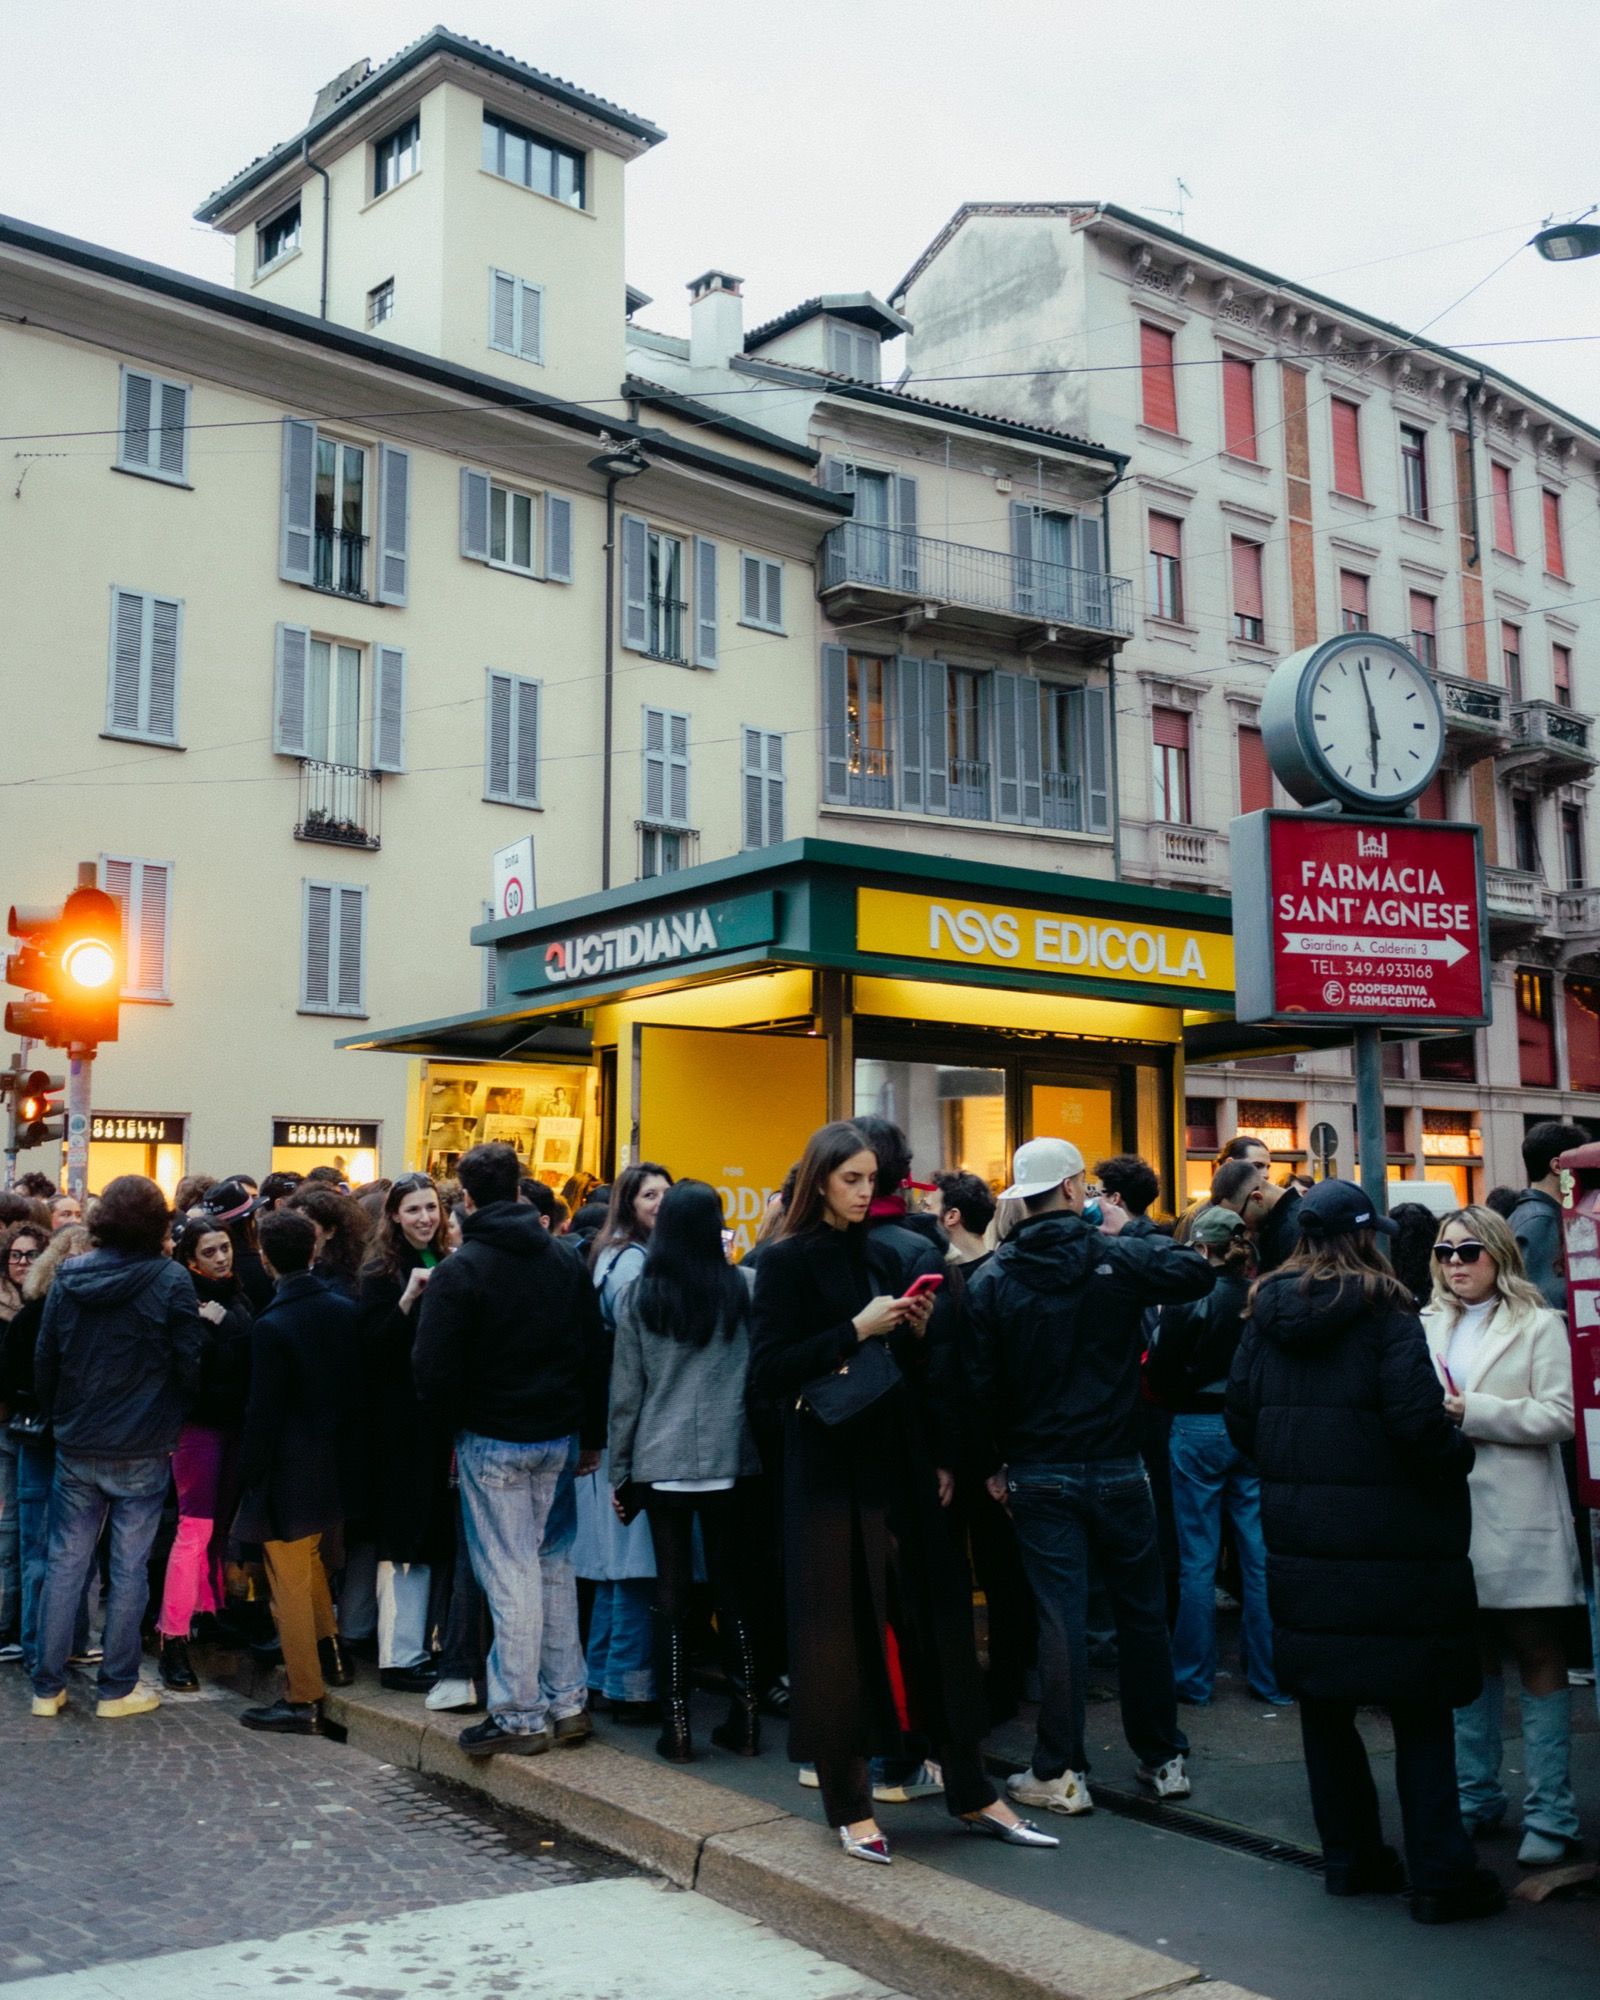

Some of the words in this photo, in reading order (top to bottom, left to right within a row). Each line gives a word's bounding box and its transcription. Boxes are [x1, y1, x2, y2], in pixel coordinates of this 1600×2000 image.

[1302, 861, 1444, 895] FARMACIA
[509, 890, 518, 908] 30
[1279, 894, 1470, 930] SANT'AGNESE
[545, 908, 718, 981] QUOTIDIANA
[1035, 918, 1206, 980] EDICOLA
[1300, 938, 1348, 952] Giardino
[1354, 941, 1364, 952] A.
[1370, 941, 1416, 954] Calderini
[1421, 943, 1428, 955] 3
[1311, 960, 1342, 974] TEL.
[1345, 961, 1433, 978] 349.4933168
[1349, 983, 1427, 995] COOPERATIVA
[1349, 995, 1436, 1008] FARMACEUTICA
[93, 1119, 164, 1130] RATELLI
[288, 1125, 360, 1136] FRATELLI
[92, 1128, 164, 1139] OSSETTI
